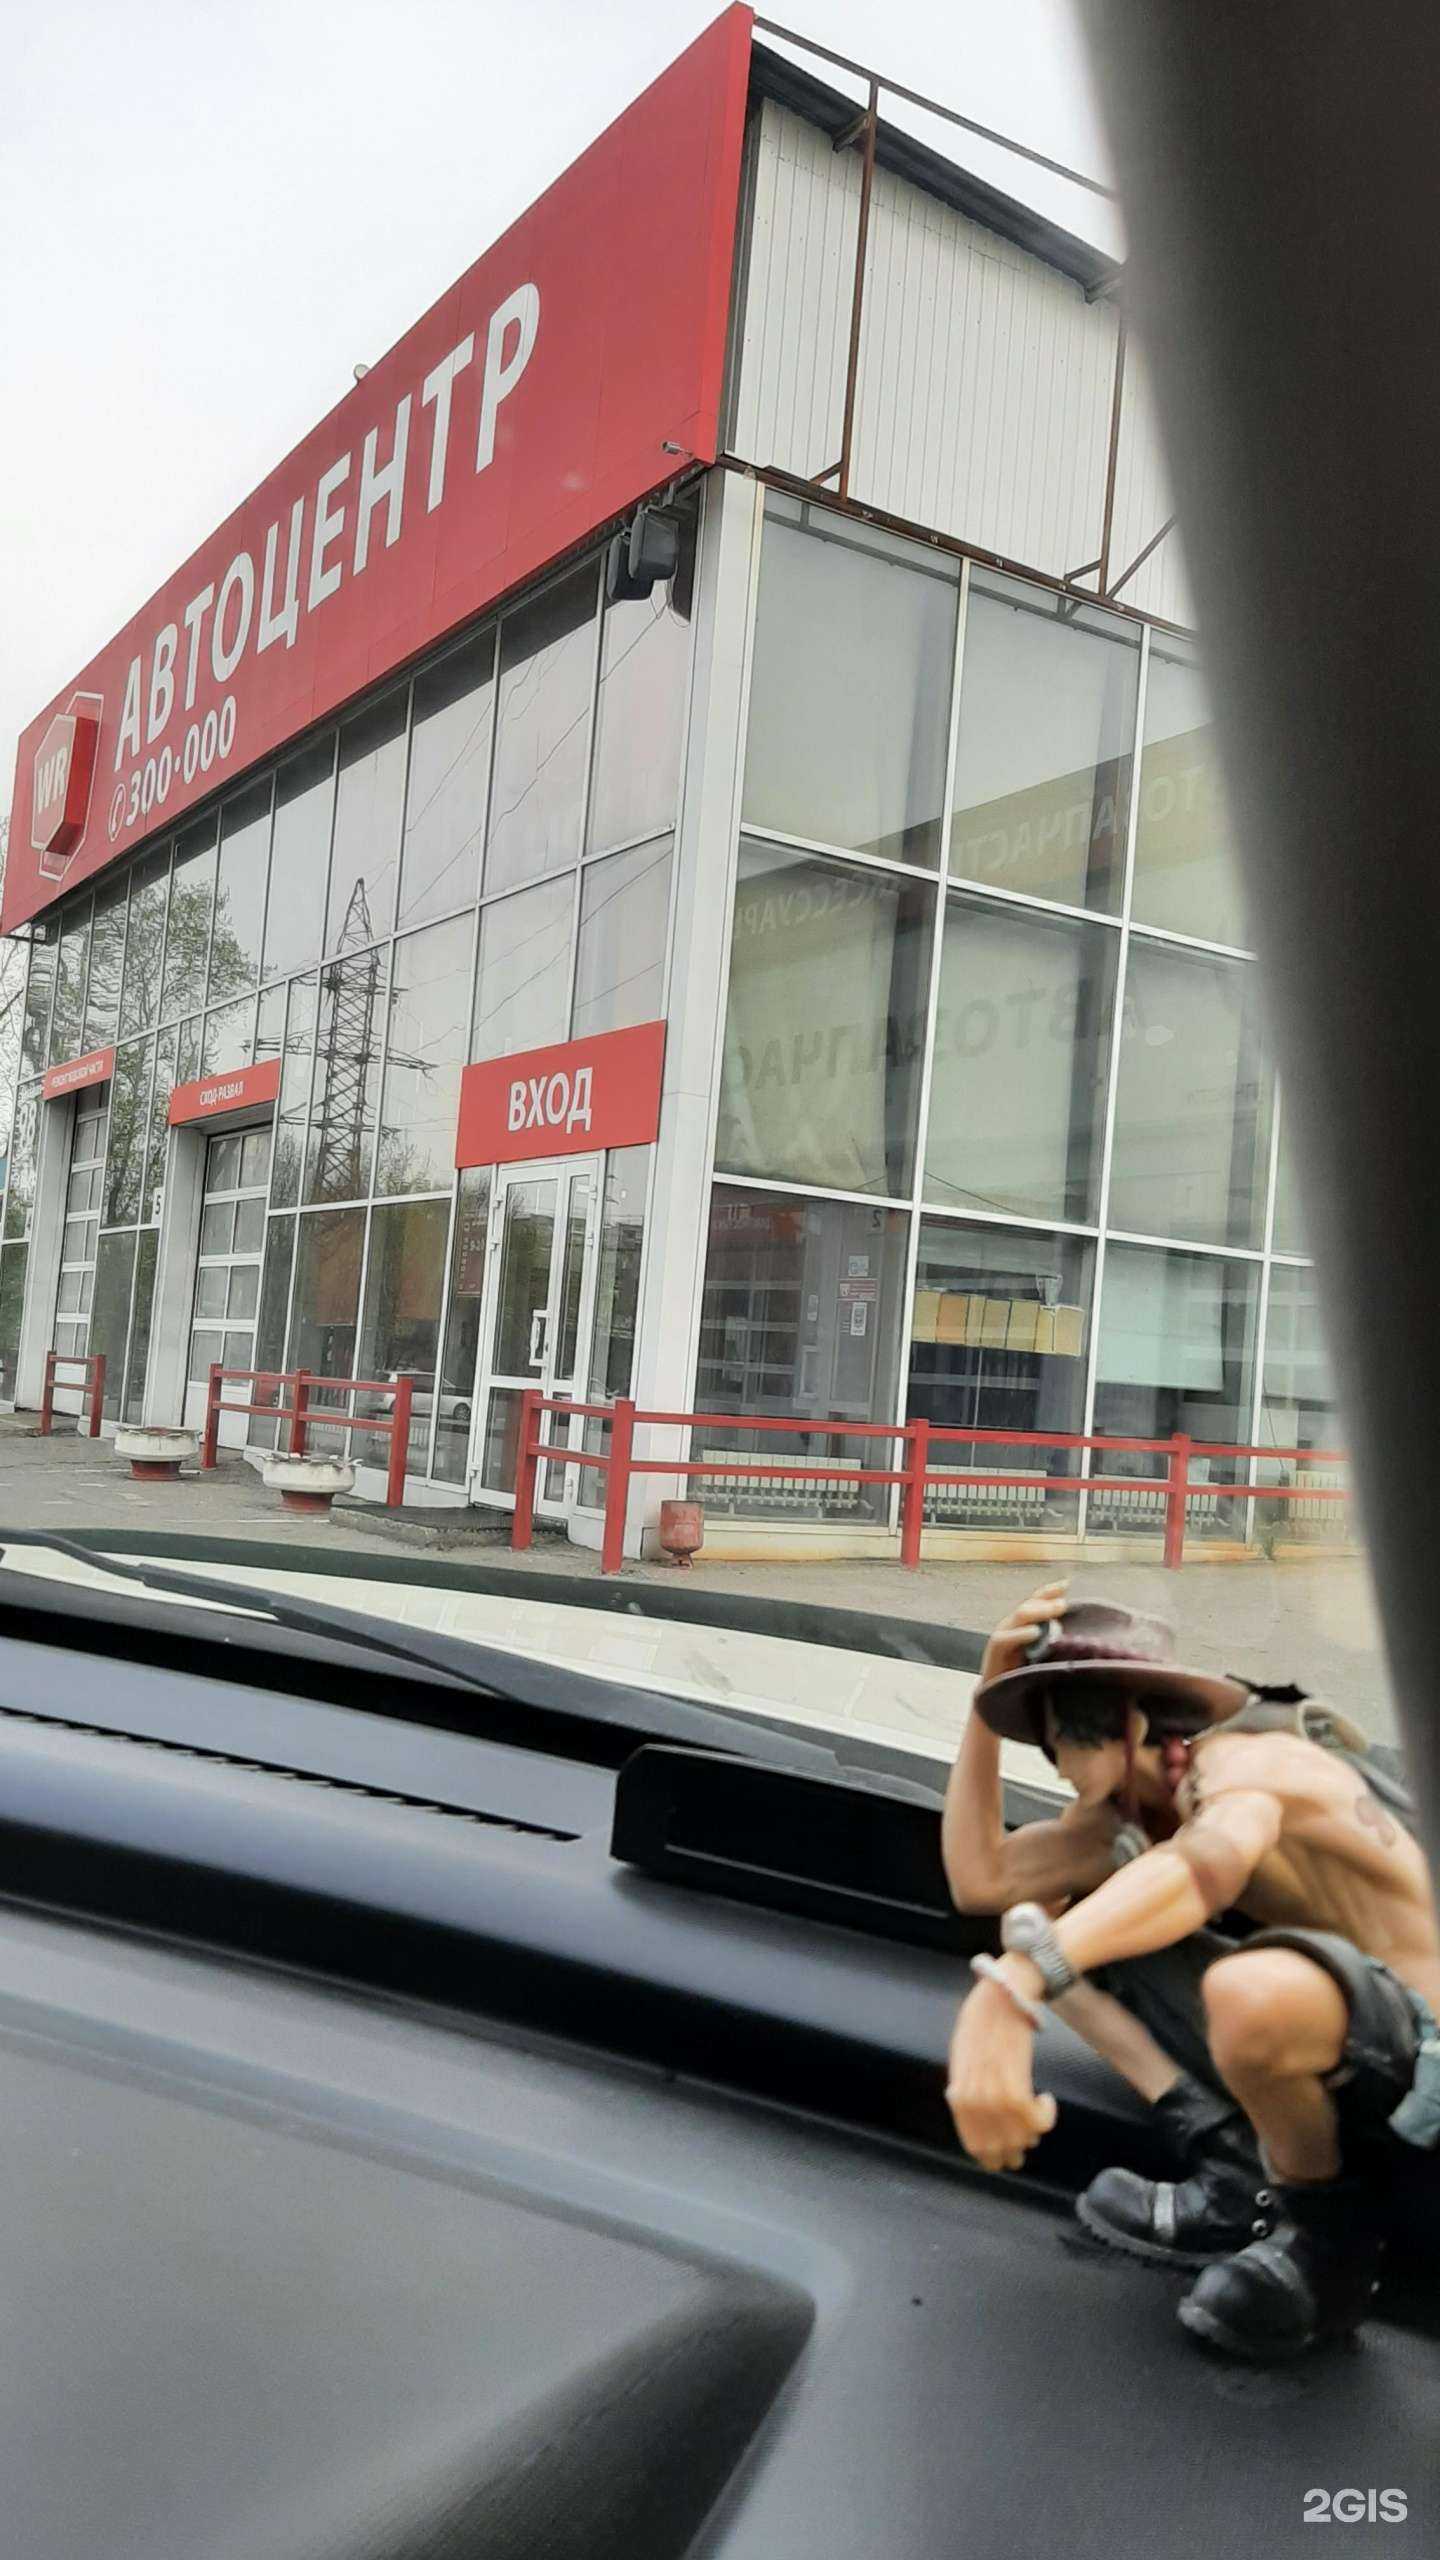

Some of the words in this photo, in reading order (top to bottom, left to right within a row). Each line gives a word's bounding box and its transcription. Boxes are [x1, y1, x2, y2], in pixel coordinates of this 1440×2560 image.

[114, 282, 540, 772] АВТОЦЕНТР
[38, 747, 68, 815] WR
[508, 1067, 593, 1134] ВХОД
[154, 1194, 162, 1215] 5
